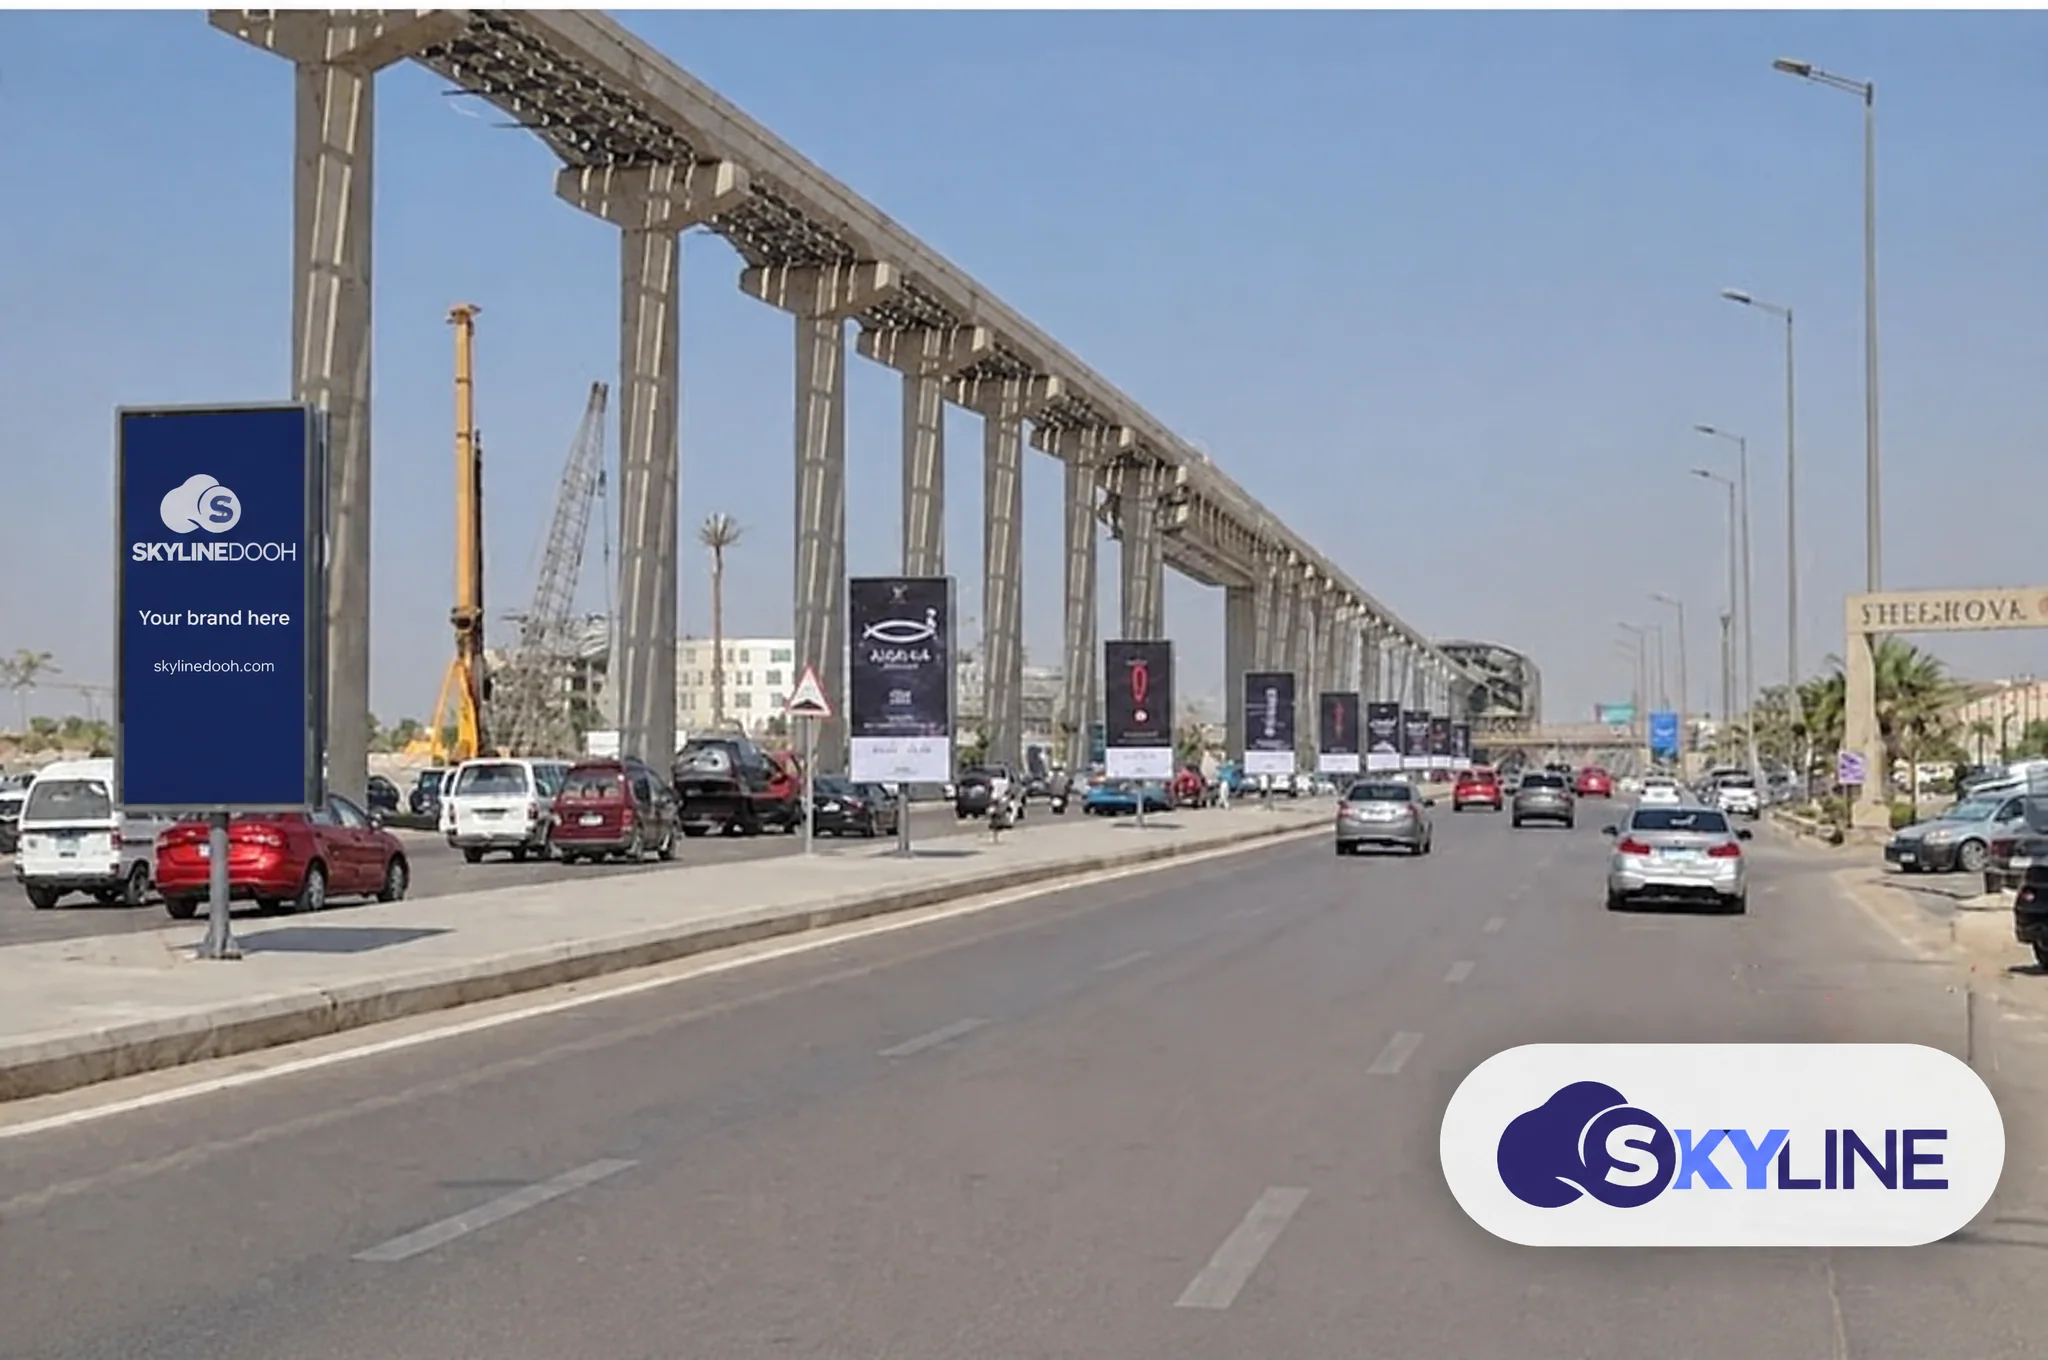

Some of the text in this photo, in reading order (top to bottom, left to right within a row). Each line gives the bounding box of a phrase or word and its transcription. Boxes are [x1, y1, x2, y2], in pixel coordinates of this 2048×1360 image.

[209, 495, 234, 524] S
[132, 542, 297, 562] SKYLINEDOOH
[139, 610, 291, 626] Your brand here
[153, 660, 275, 675] skylinedooh.com
